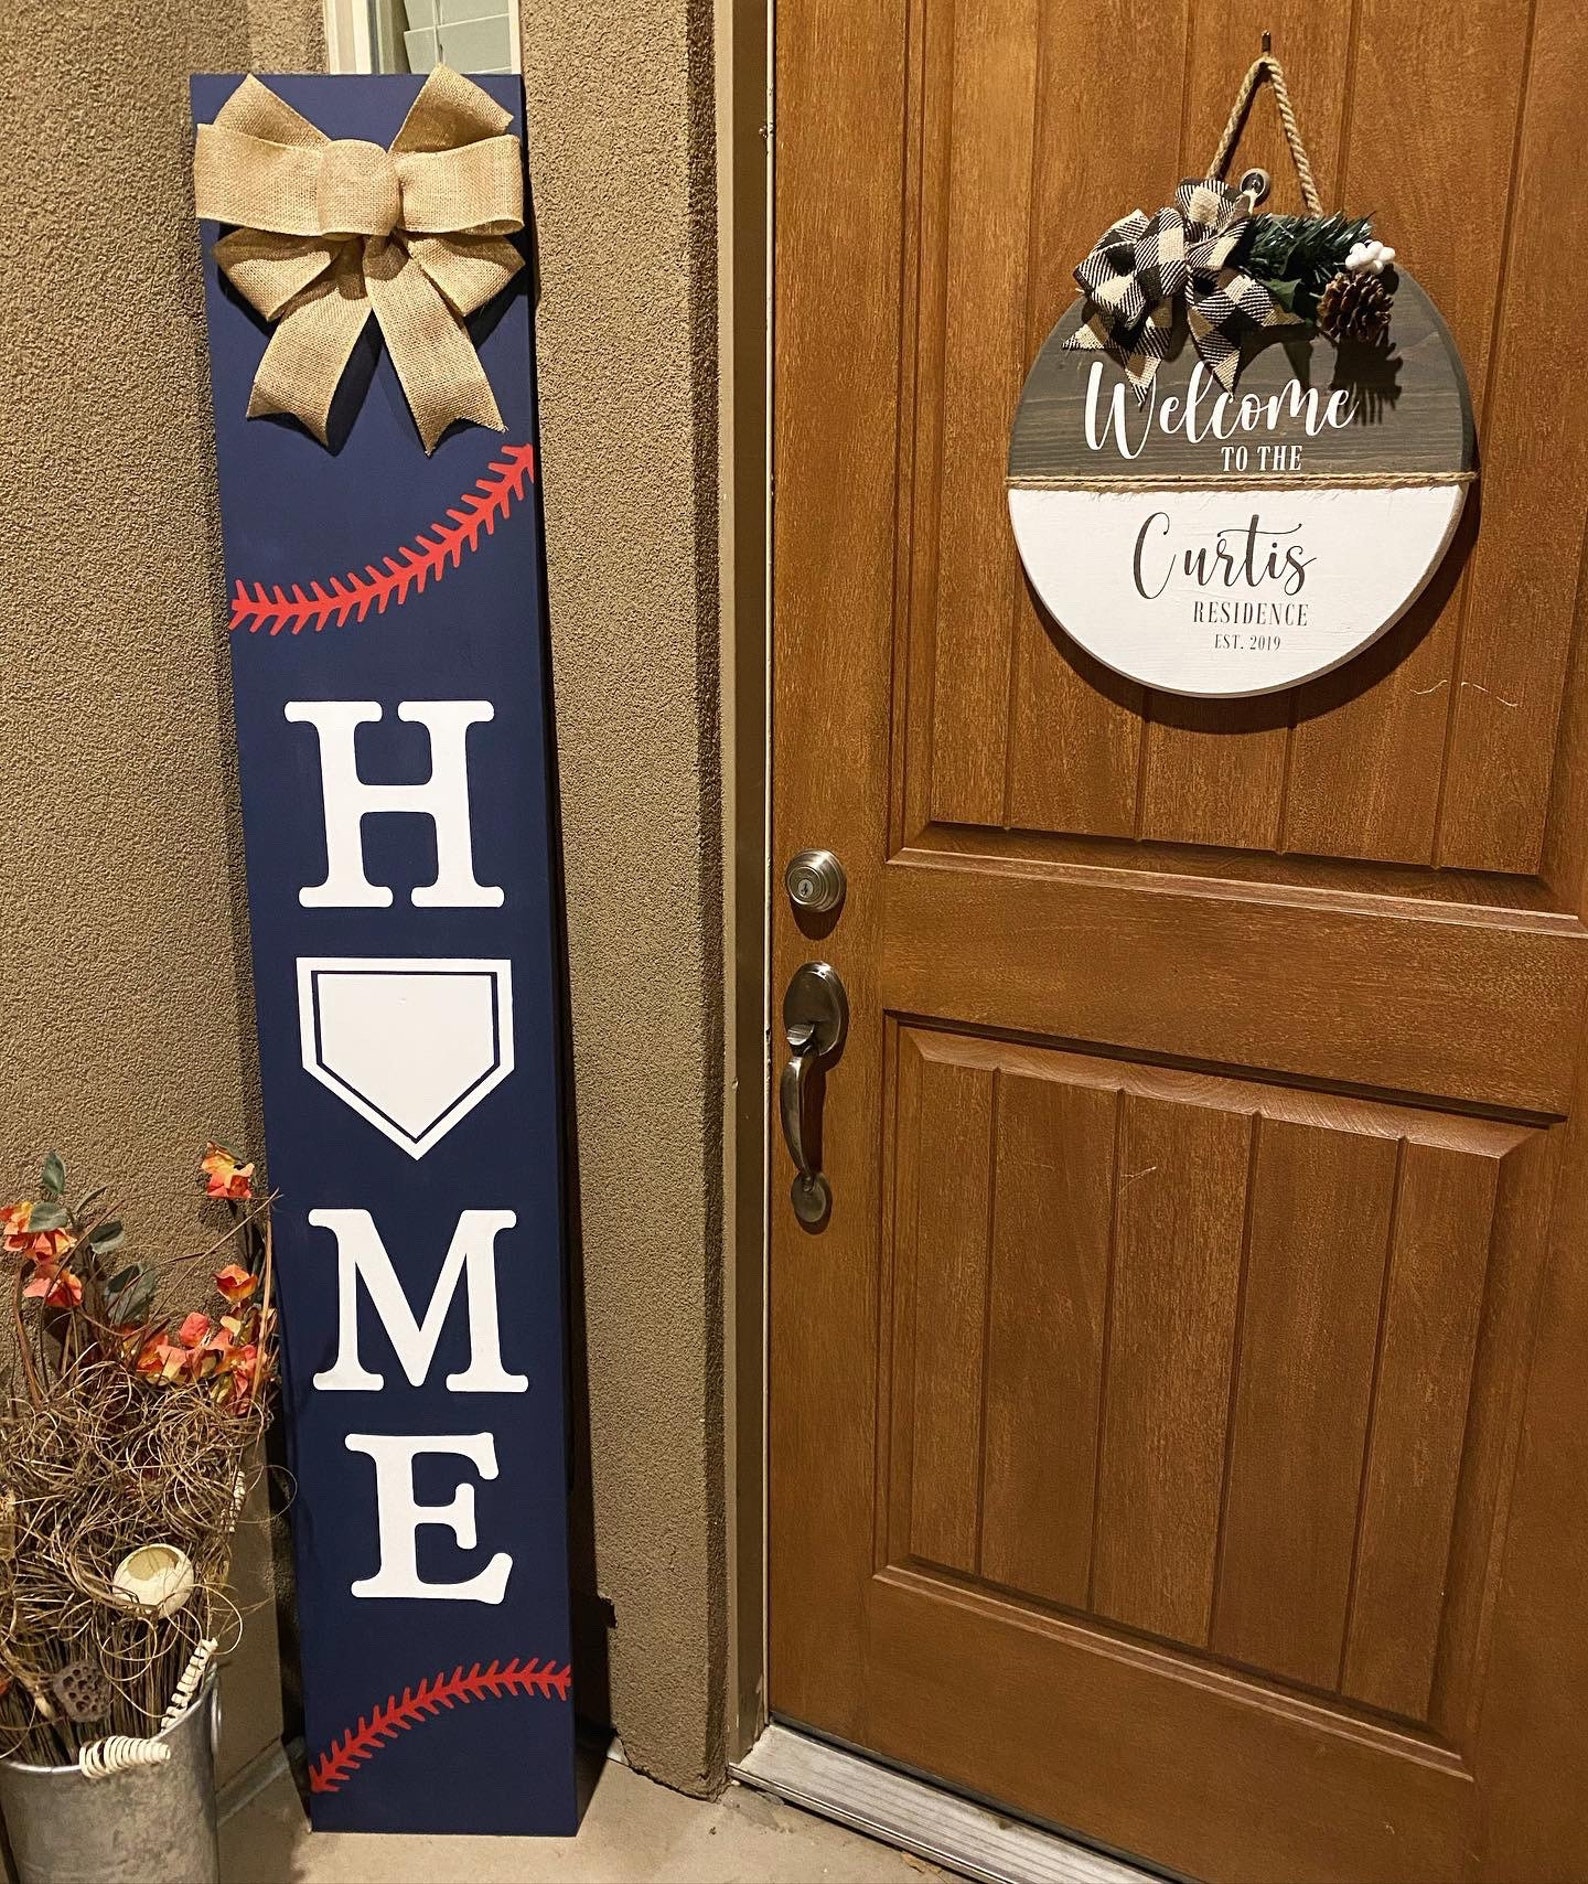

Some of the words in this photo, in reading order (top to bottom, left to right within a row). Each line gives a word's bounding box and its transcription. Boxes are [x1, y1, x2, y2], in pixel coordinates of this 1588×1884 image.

[1084, 361, 1359, 460] Welcome
[1221, 445, 1249, 472] TO
[1257, 445, 1303, 472] THE
[1133, 511, 1318, 600] Curtis
[1193, 601, 1309, 626] RESIDENCE
[1214, 634, 1245, 650] EST.
[1249, 635, 1282, 651] 2019
